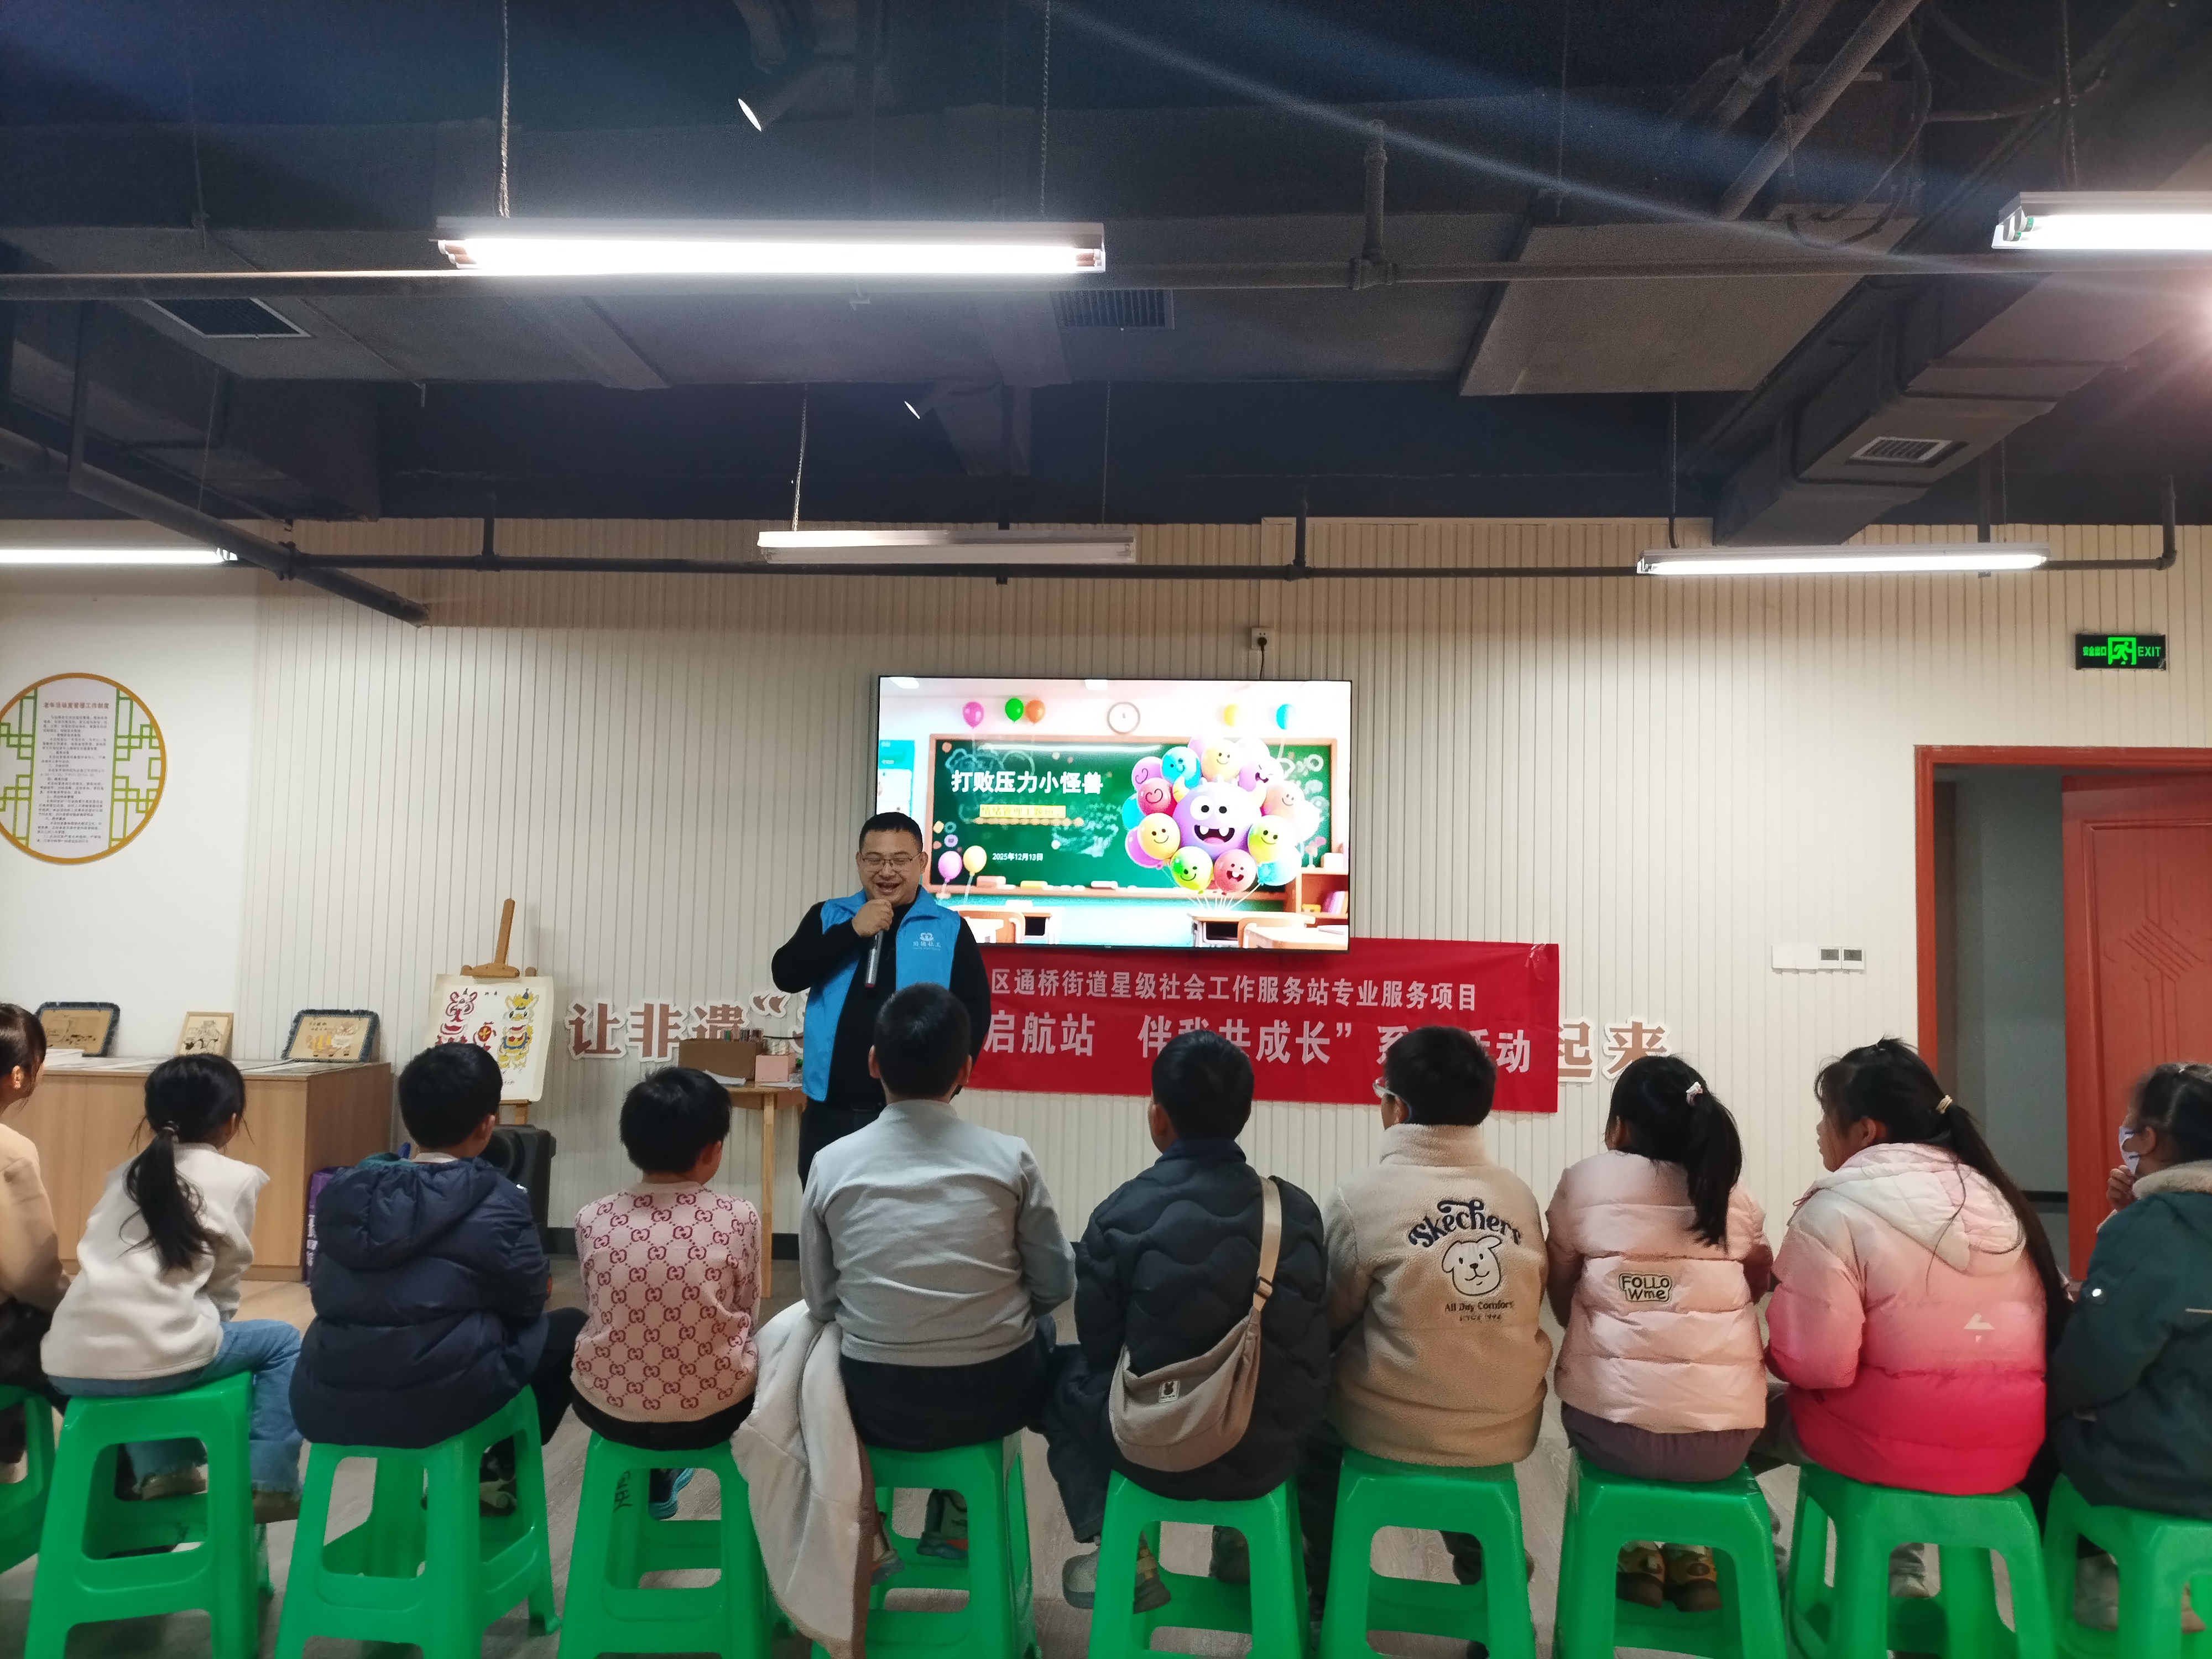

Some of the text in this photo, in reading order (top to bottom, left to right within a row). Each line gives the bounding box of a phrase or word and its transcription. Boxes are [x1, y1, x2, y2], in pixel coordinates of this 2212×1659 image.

[2083, 646, 2107, 656] 安全出口
[2138, 646, 2161, 656] EXIT
[951, 769, 1103, 795] 打败压力小怪兽
[992, 852, 1043, 861] 2025年12月13日
[992, 969, 1475, 1011] 区通桥街道星级社会工作服务站专业服务项目
[568, 994, 804, 1058] 让非遗“
[984, 1010, 1530, 1073] 启航站 伴共成长”系动
[1621, 1276, 1670, 1289] FOLLO
[1445, 1300, 1514, 1312] All Day Comfort
